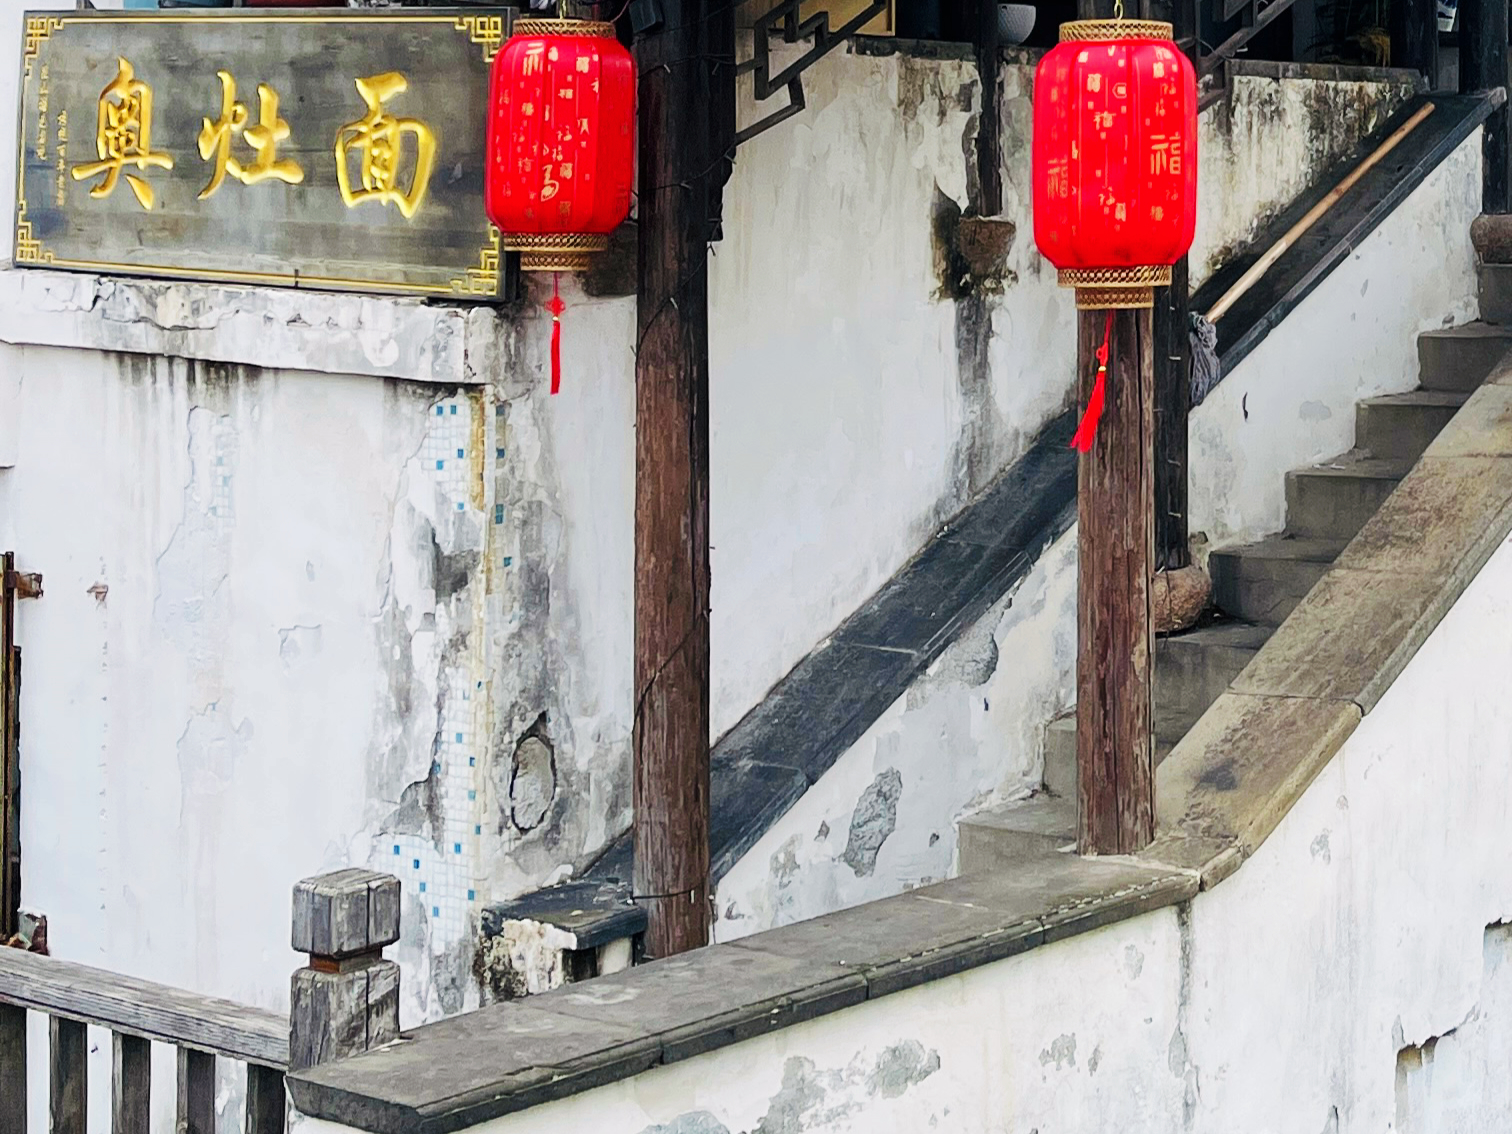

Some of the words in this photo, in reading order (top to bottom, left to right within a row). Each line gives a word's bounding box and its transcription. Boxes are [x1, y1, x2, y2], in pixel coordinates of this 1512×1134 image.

[71, 56, 436, 218] 奥灶面
[1151, 133, 1182, 176] 福
